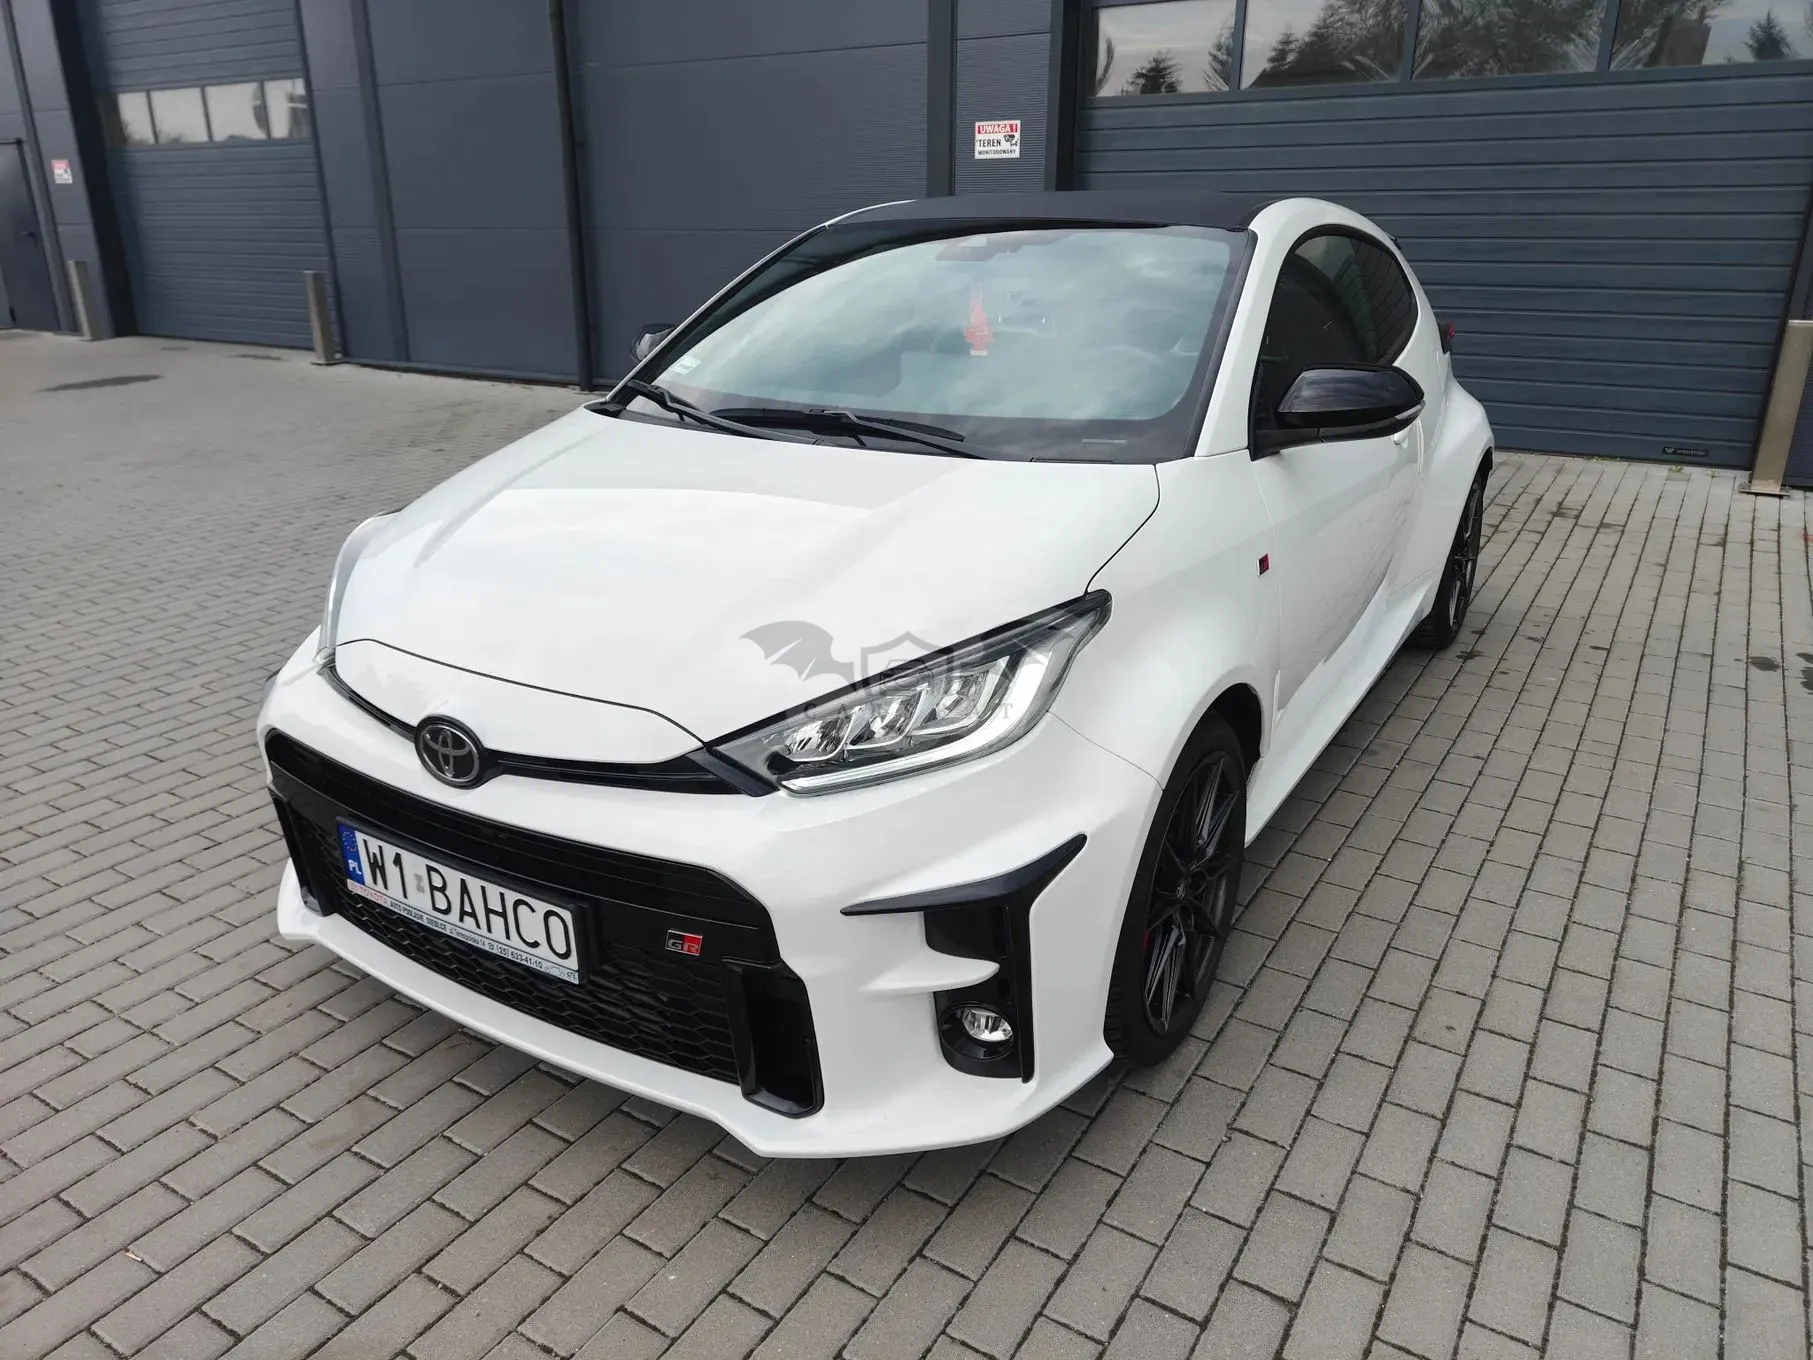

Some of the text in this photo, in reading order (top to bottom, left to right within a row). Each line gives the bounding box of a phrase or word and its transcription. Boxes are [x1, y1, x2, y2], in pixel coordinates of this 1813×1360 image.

[980, 124, 1010, 134] UWAGA
[978, 139, 1001, 147] TEREN
[348, 859, 362, 875] PL
[363, 838, 571, 960] W1 BAHCO
[668, 939, 699, 953] GR
